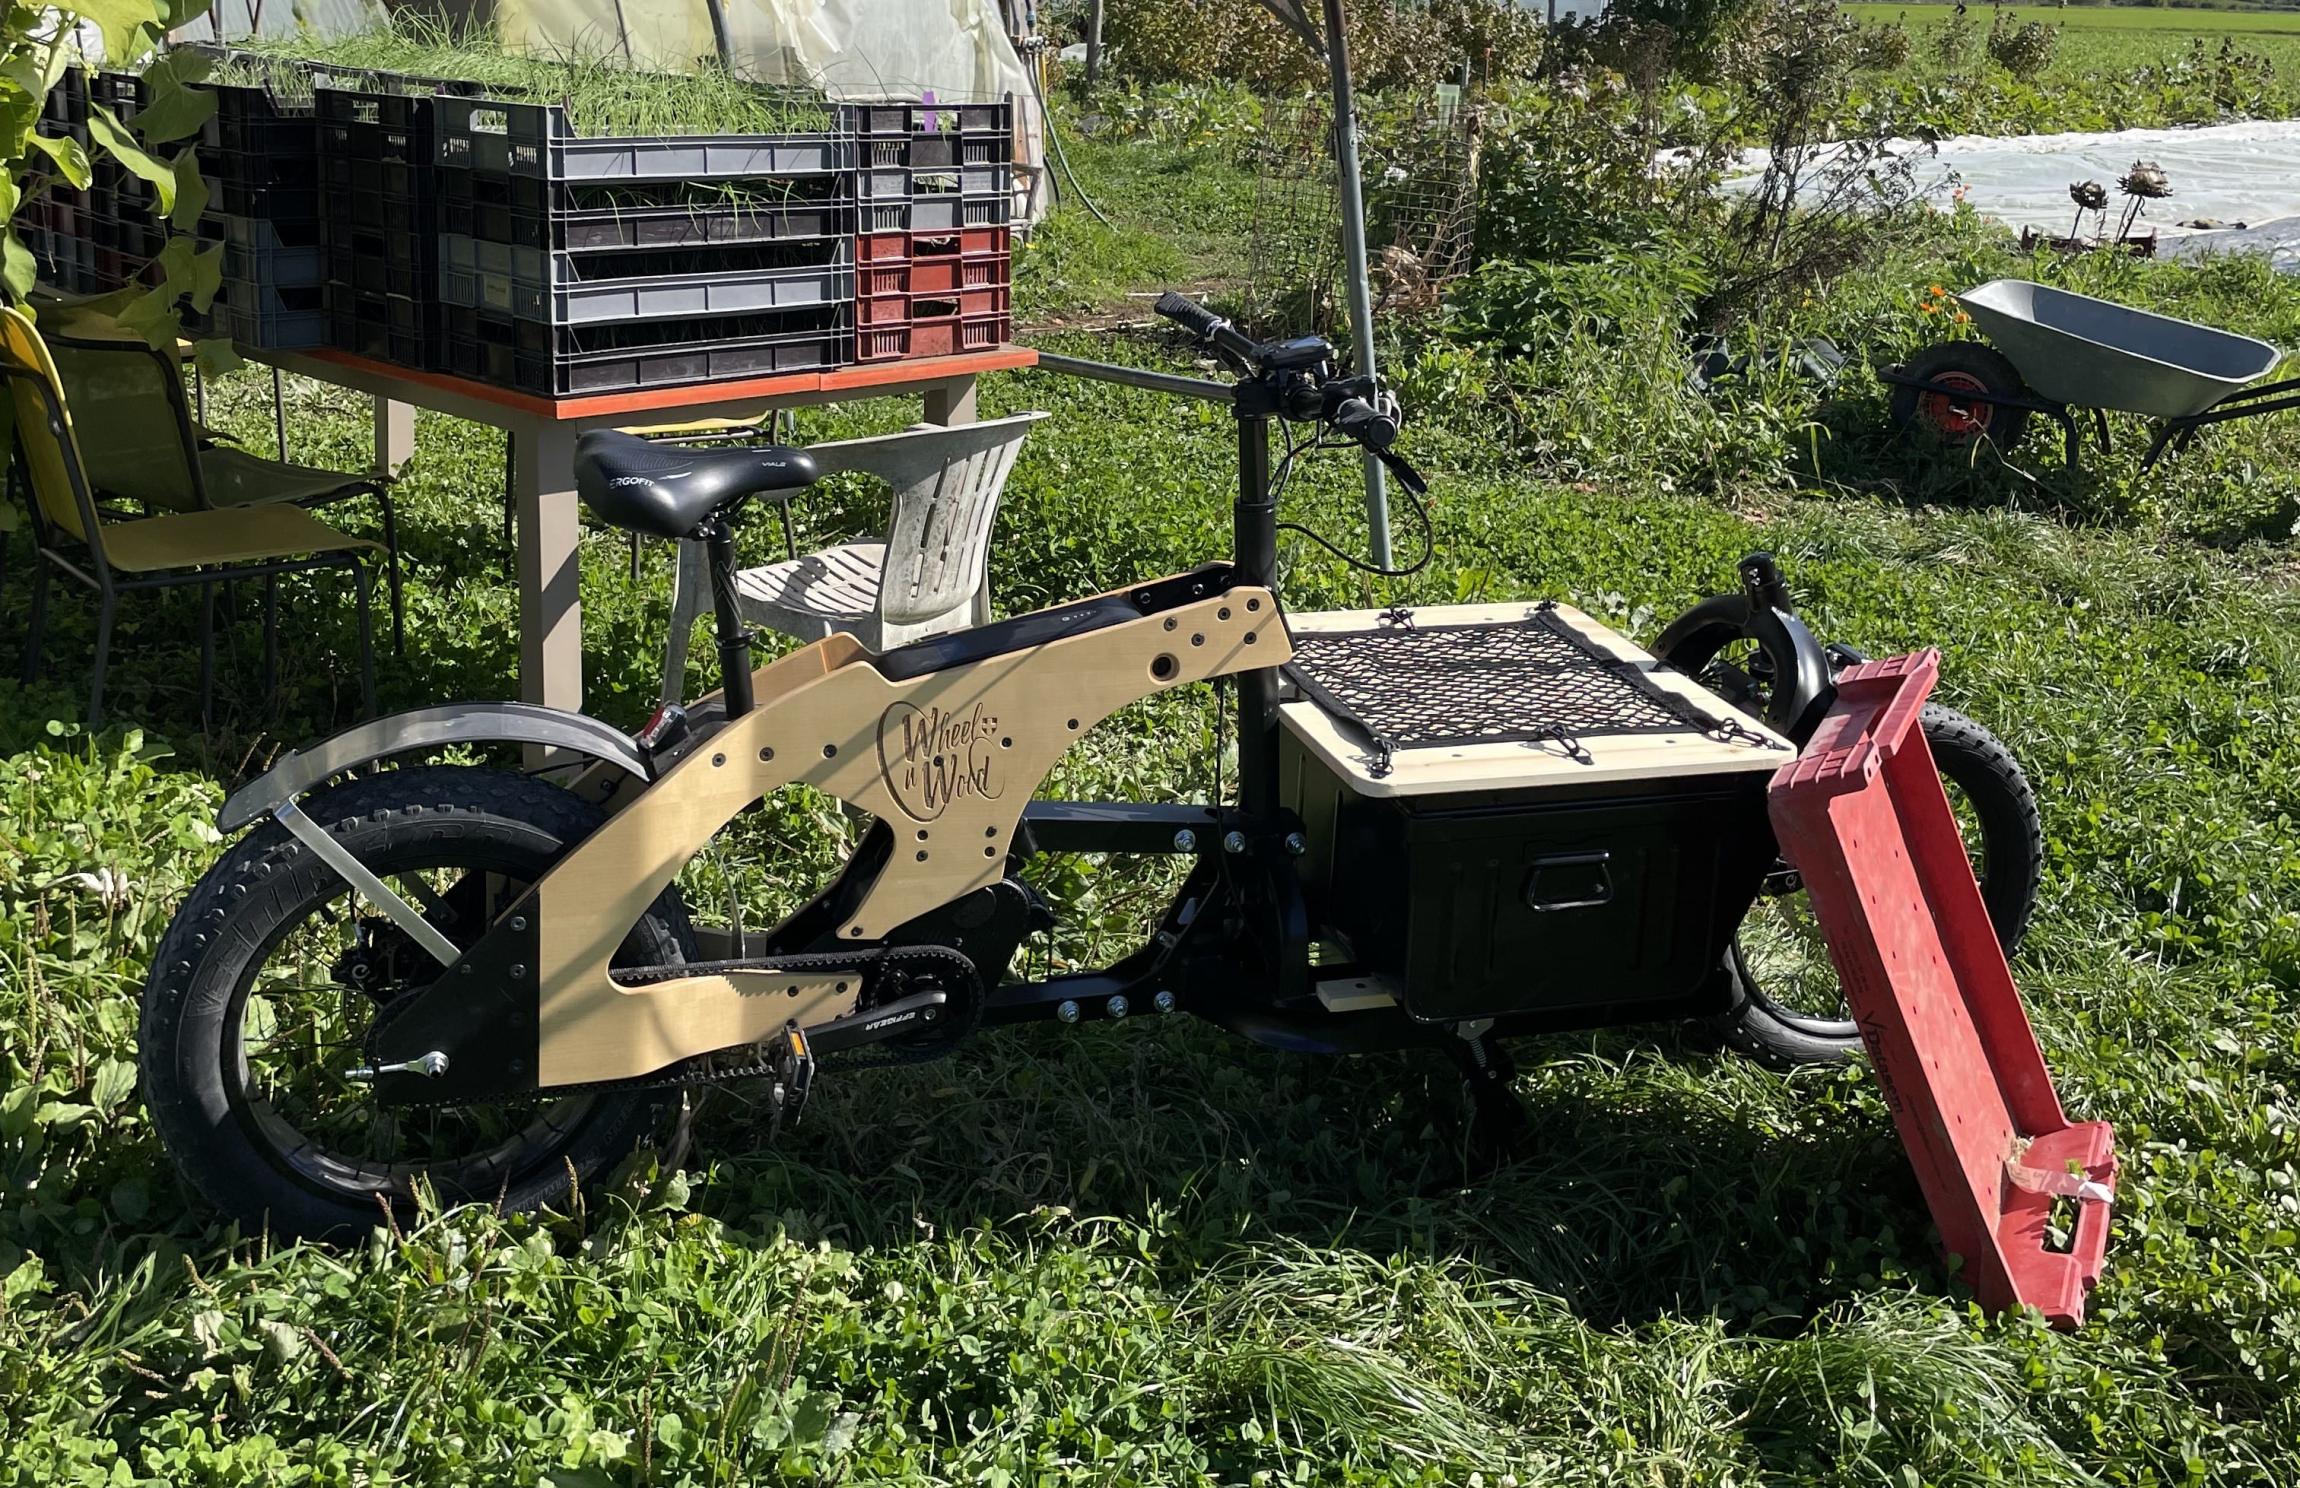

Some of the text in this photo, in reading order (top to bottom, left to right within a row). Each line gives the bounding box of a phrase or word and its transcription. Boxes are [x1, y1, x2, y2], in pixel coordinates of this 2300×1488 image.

[609, 476, 655, 490] ERGOFIT
[902, 702, 984, 763] Wheel
[922, 754, 991, 810] Wood
[865, 1012, 916, 1031] EFFIGEAR
[1864, 1028, 1904, 1115] Datasem
